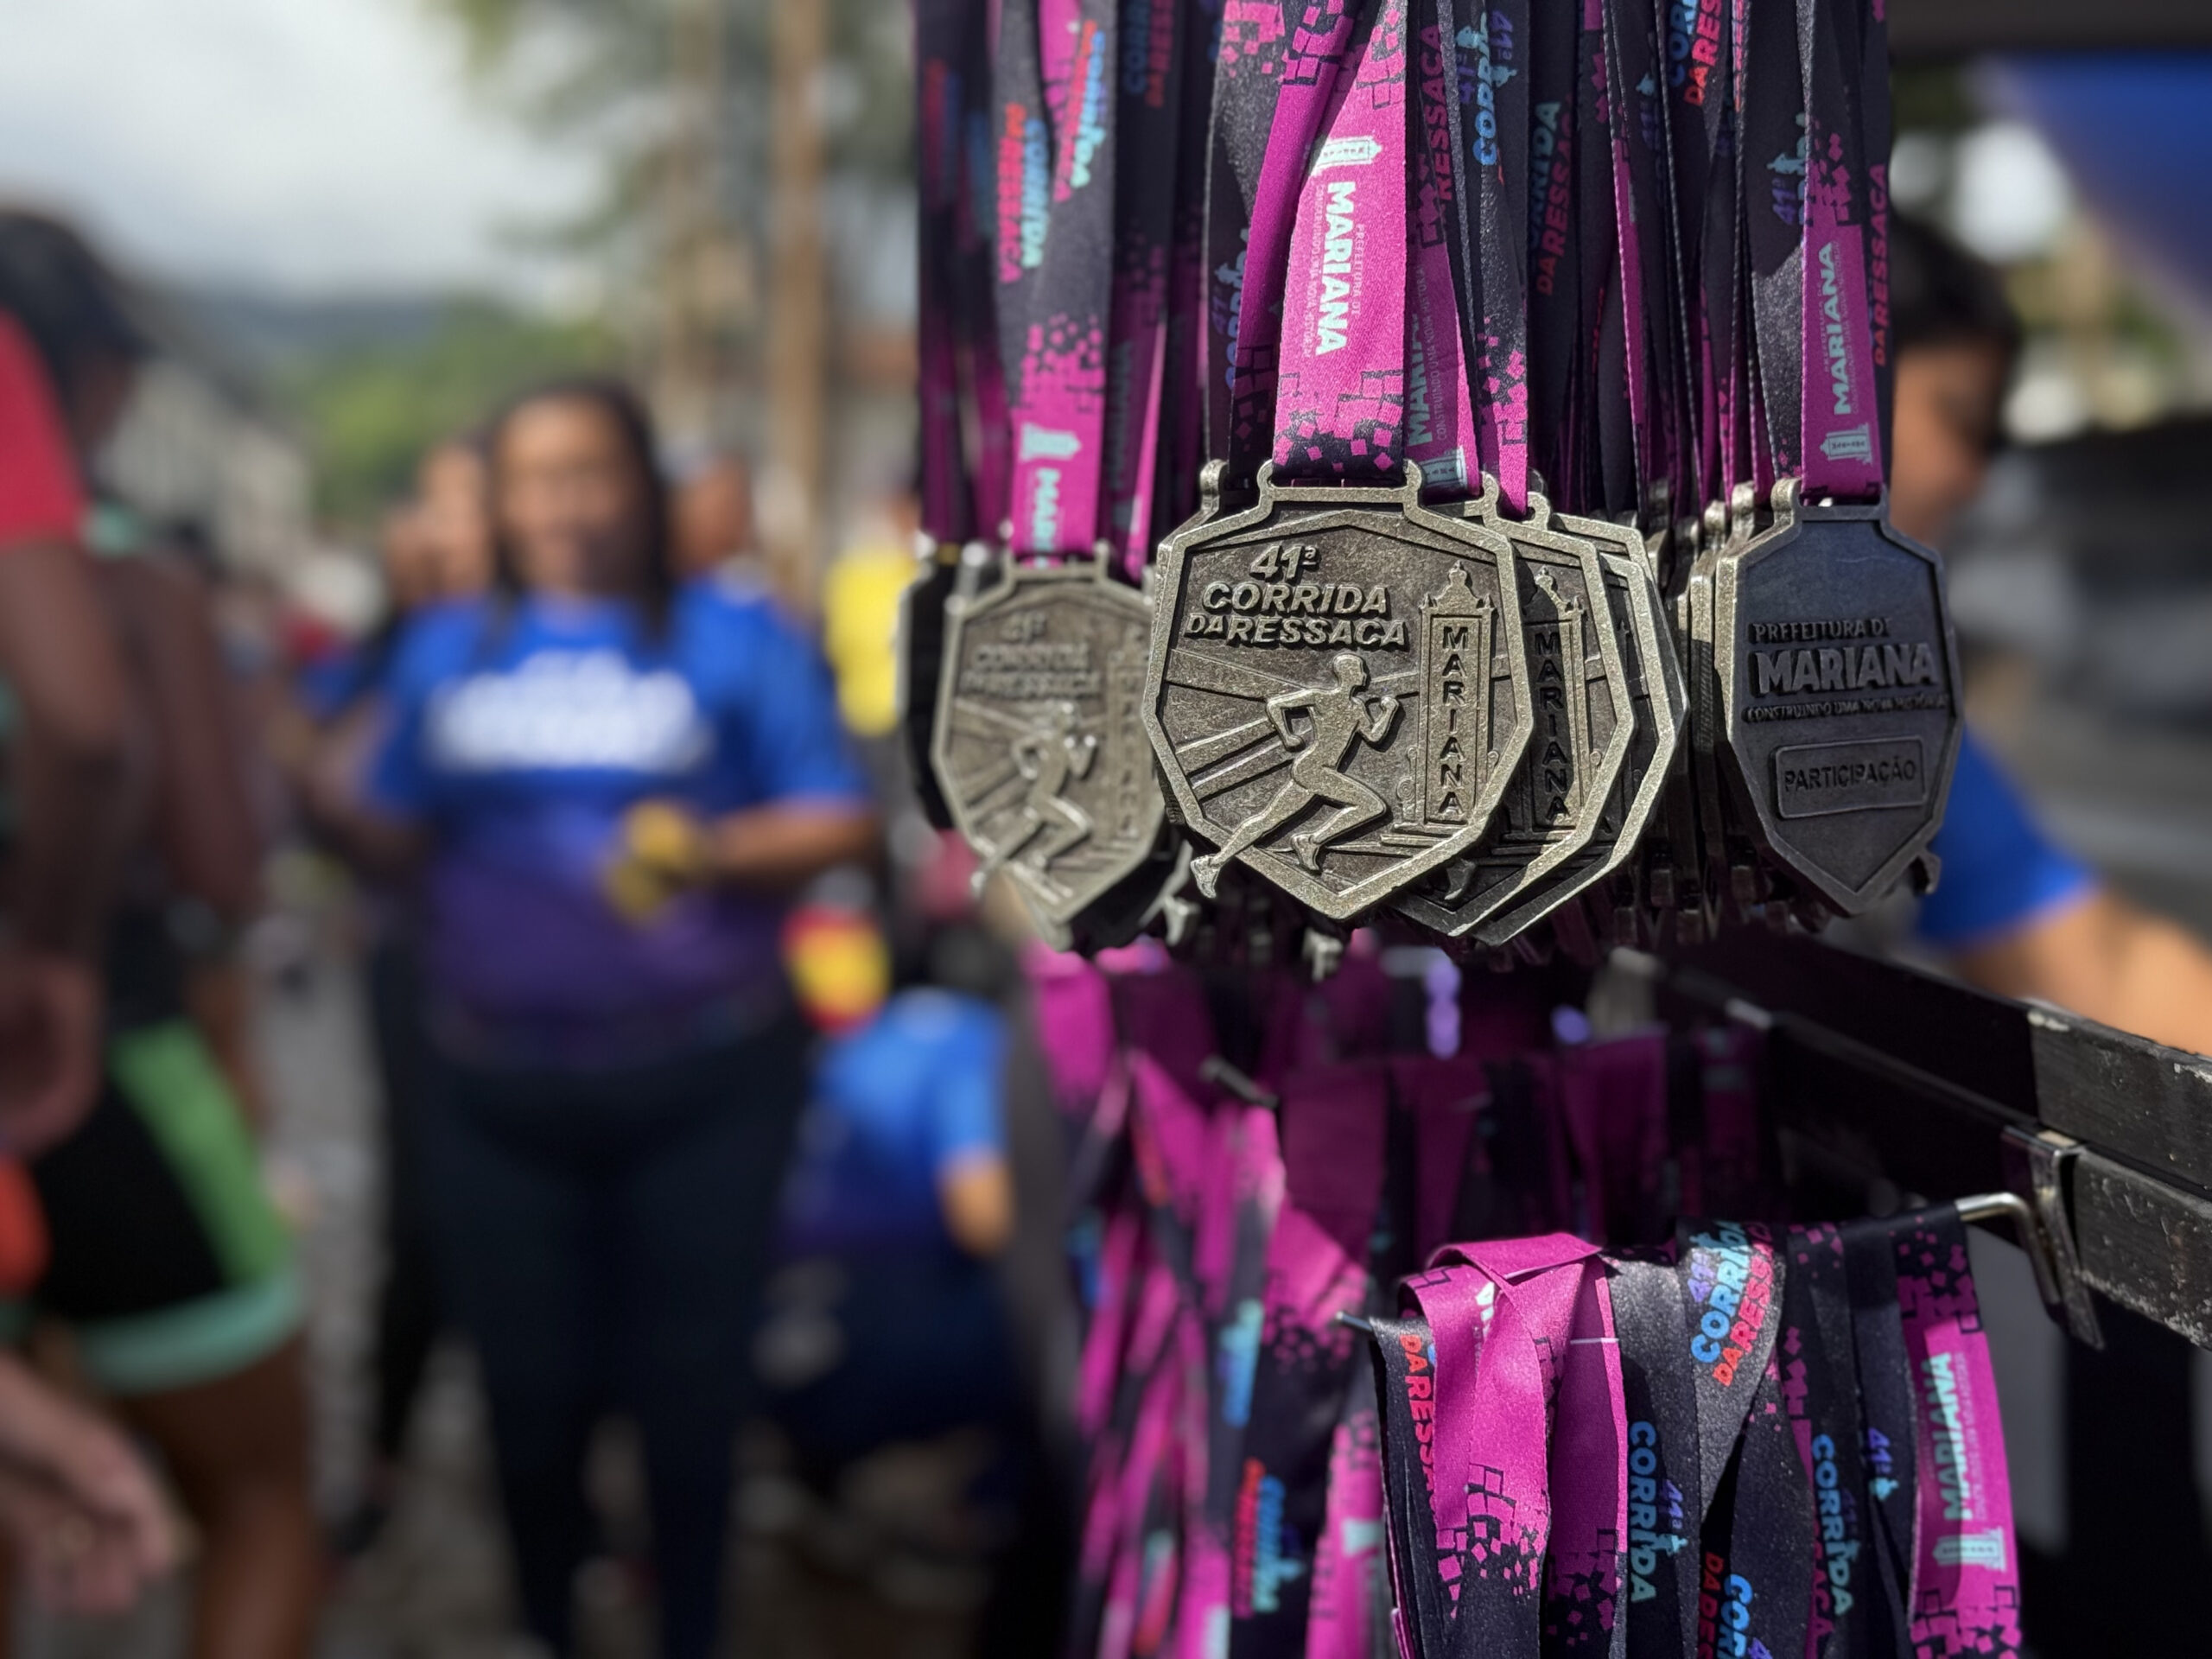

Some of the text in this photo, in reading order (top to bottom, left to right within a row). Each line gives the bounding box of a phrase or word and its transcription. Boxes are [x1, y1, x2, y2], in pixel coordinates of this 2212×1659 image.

[1315, 181, 1357, 356] MARIANA
[1819, 241, 1852, 415] MARIANA
[1202, 581, 1391, 619] CORRIDA
[1751, 622, 1866, 645] PREFEITURA
[1751, 643, 1940, 696] MARIANA
[1439, 625, 1469, 815] MARIANA
[1534, 632, 1572, 821] MARIANA
[1783, 754, 1918, 792] PARTICIPAÇÃO
[1630, 1421, 1657, 1603] CORRIDA
[1920, 1351, 1974, 1521] MARIANA
[1812, 1433, 1853, 1615] CORRIDA
